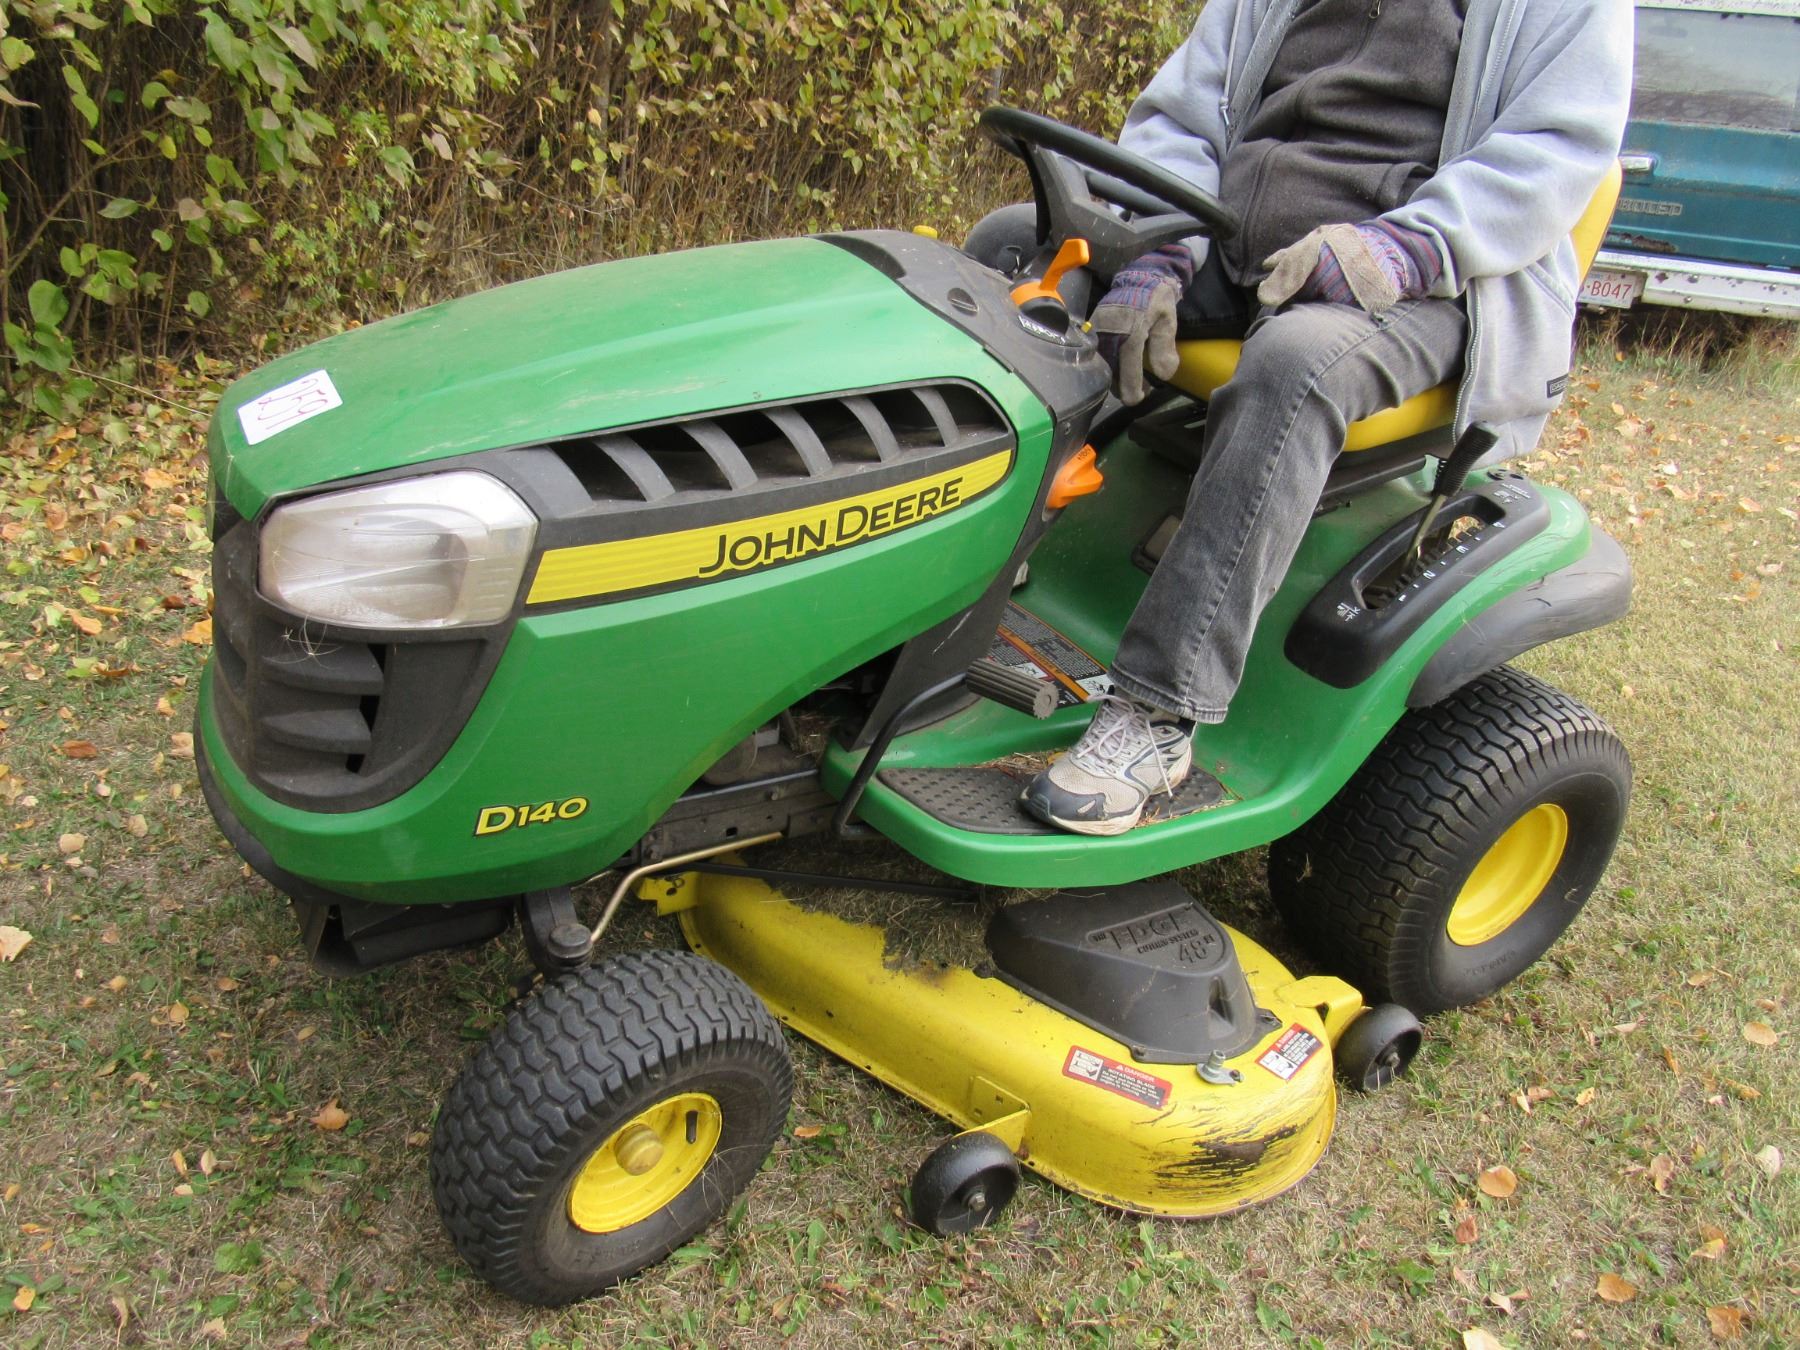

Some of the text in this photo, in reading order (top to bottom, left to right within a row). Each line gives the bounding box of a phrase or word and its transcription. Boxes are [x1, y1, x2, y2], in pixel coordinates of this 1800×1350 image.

[699, 477, 963, 573] JOHN DEERE
[475, 797, 587, 835] D140
